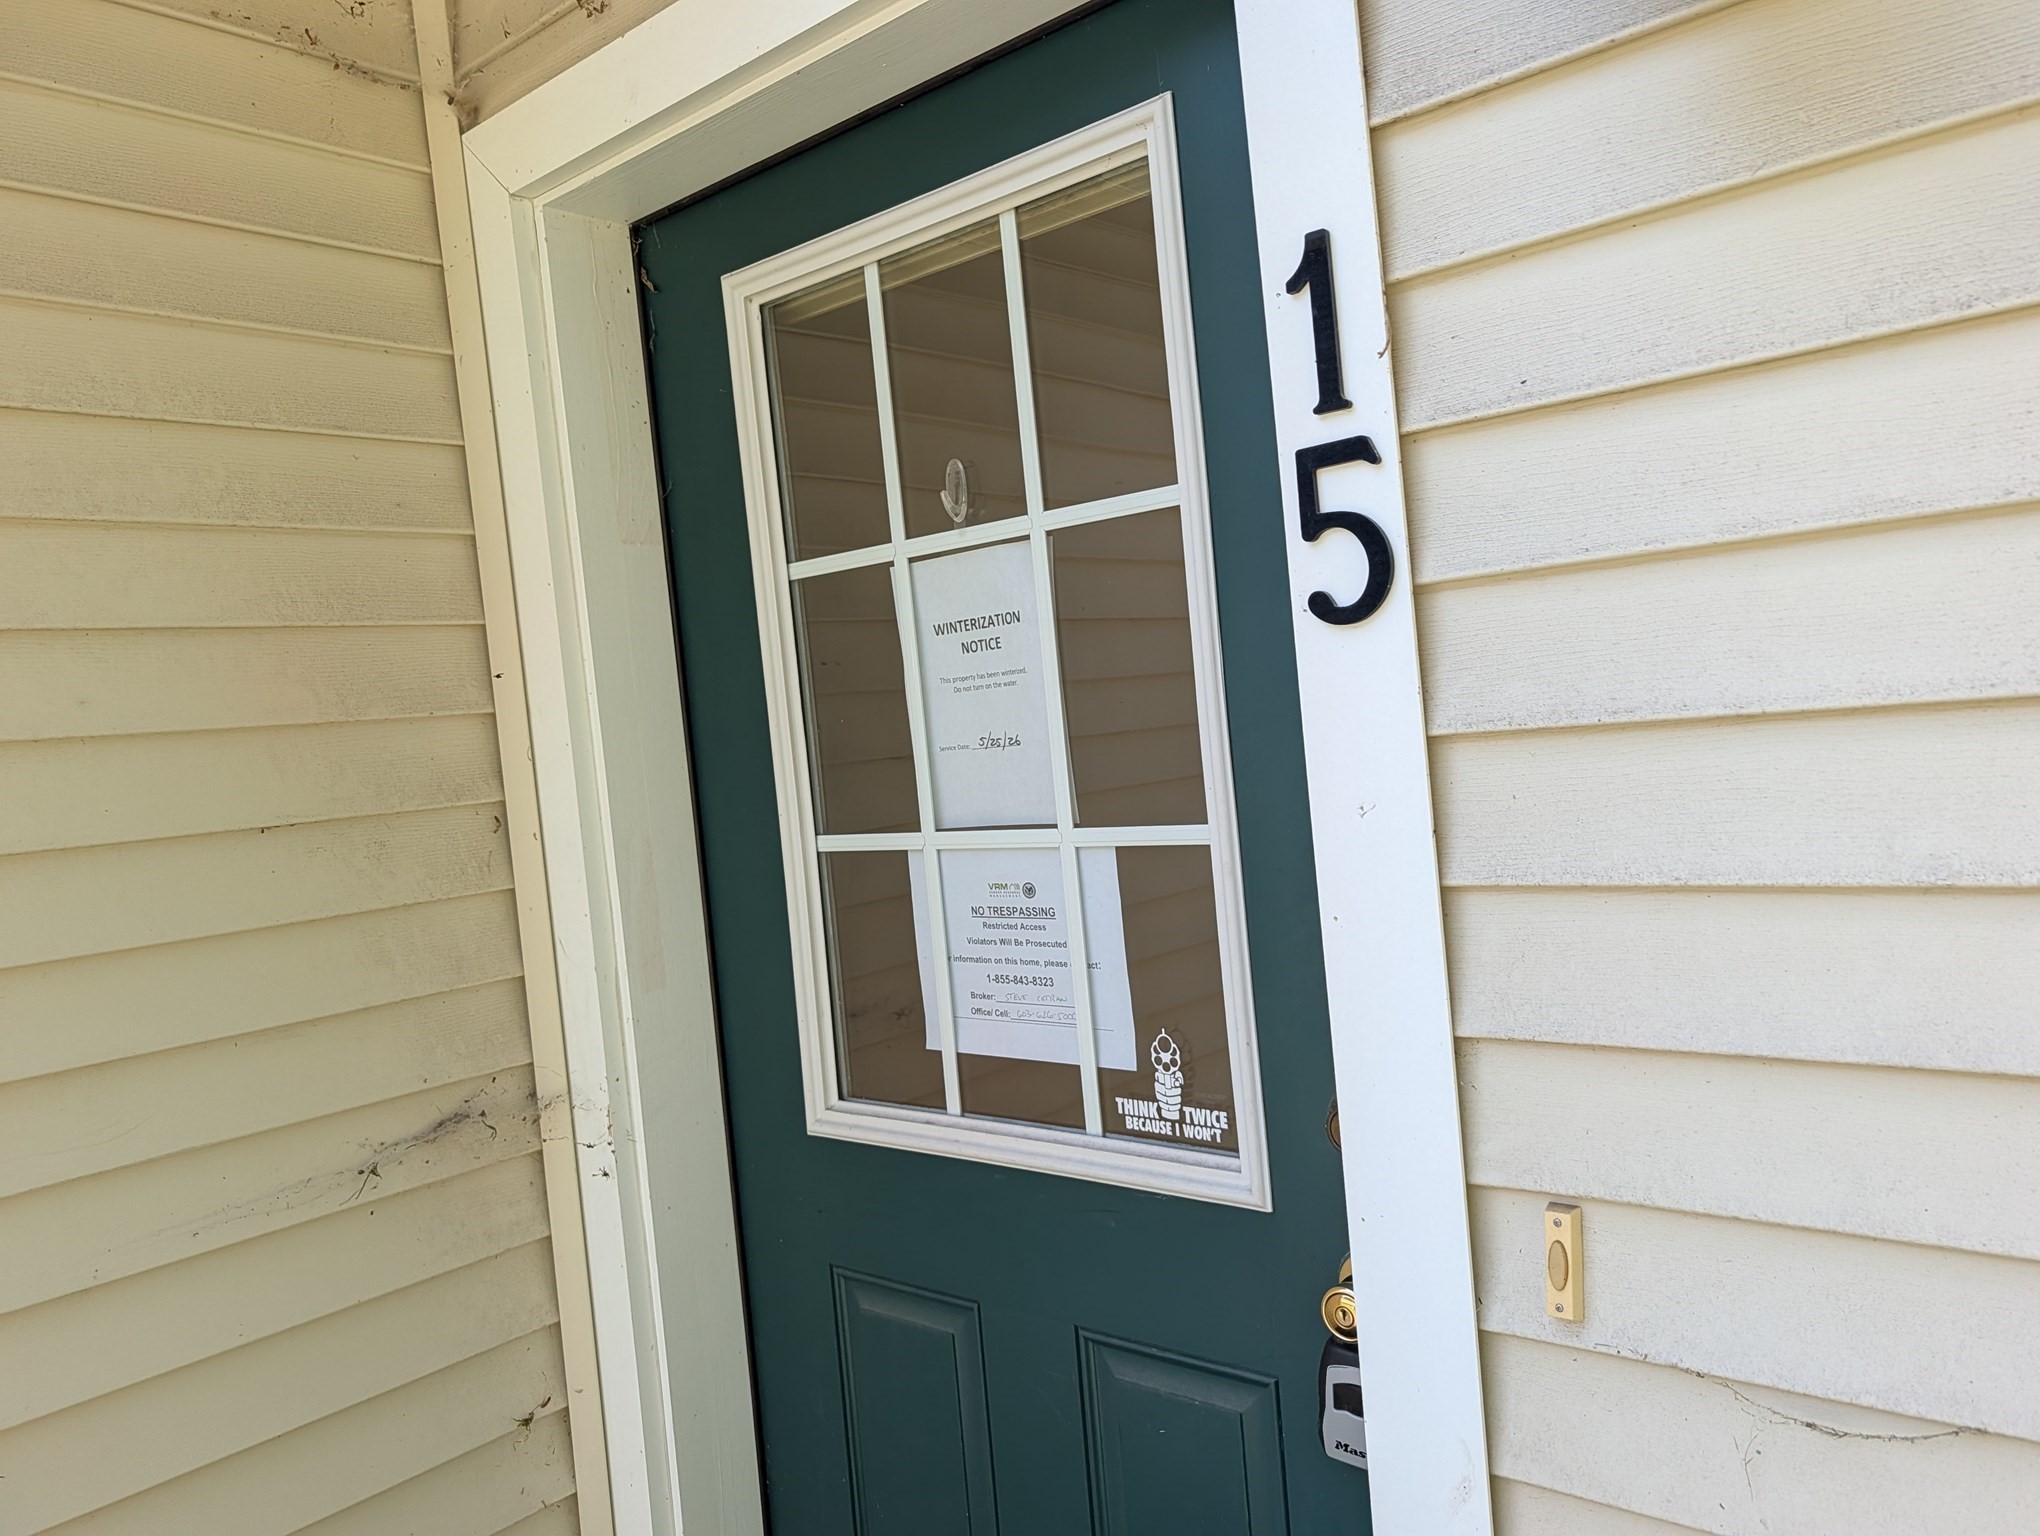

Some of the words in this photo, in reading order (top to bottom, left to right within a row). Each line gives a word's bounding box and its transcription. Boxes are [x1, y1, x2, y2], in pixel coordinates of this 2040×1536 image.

[1286, 228, 1395, 625] 15
[932, 609, 1021, 637] WINTERIZATION
[960, 636, 1002, 655] NOTICE
[939, 677, 952, 685] This
[952, 674, 976, 685] property
[976, 672, 986, 680] has
[986, 671, 1000, 679] been
[953, 686, 962, 694] Do
[962, 685, 973, 693] not
[992, 681, 1003, 689] the
[978, 730, 1022, 751] 5/25/26
[938, 744, 957, 753] Service
[957, 743, 971, 751] Date:
[987, 882, 1009, 891] VRM
[970, 905, 985, 917] NO
[986, 906, 1056, 919] TRESPASSING
[982, 921, 1019, 931] Restricted
[1019, 922, 1047, 932] Access
[966, 936, 998, 946] Violators
[998, 937, 1013, 946] Will
[1014, 938, 1024, 947] Be
[1025, 939, 1068, 949] Prosecuted
[952, 954, 993, 964] information
[1004, 957, 1018, 966] this
[1019, 957, 1042, 968] home,
[1043, 960, 1069, 968] please
[986, 973, 1055, 988] 1-855-843-8323
[970, 991, 997, 1001] Broker:
[994, 1008, 1011, 1018] Cell:
[1115, 1096, 1160, 1120] THINK
[1182, 1106, 1229, 1130] TWICE
[1125, 1116, 1173, 1136] BECAUSE
[1175, 1122, 1181, 1137] I
[1182, 1123, 1222, 1144] WON'T
